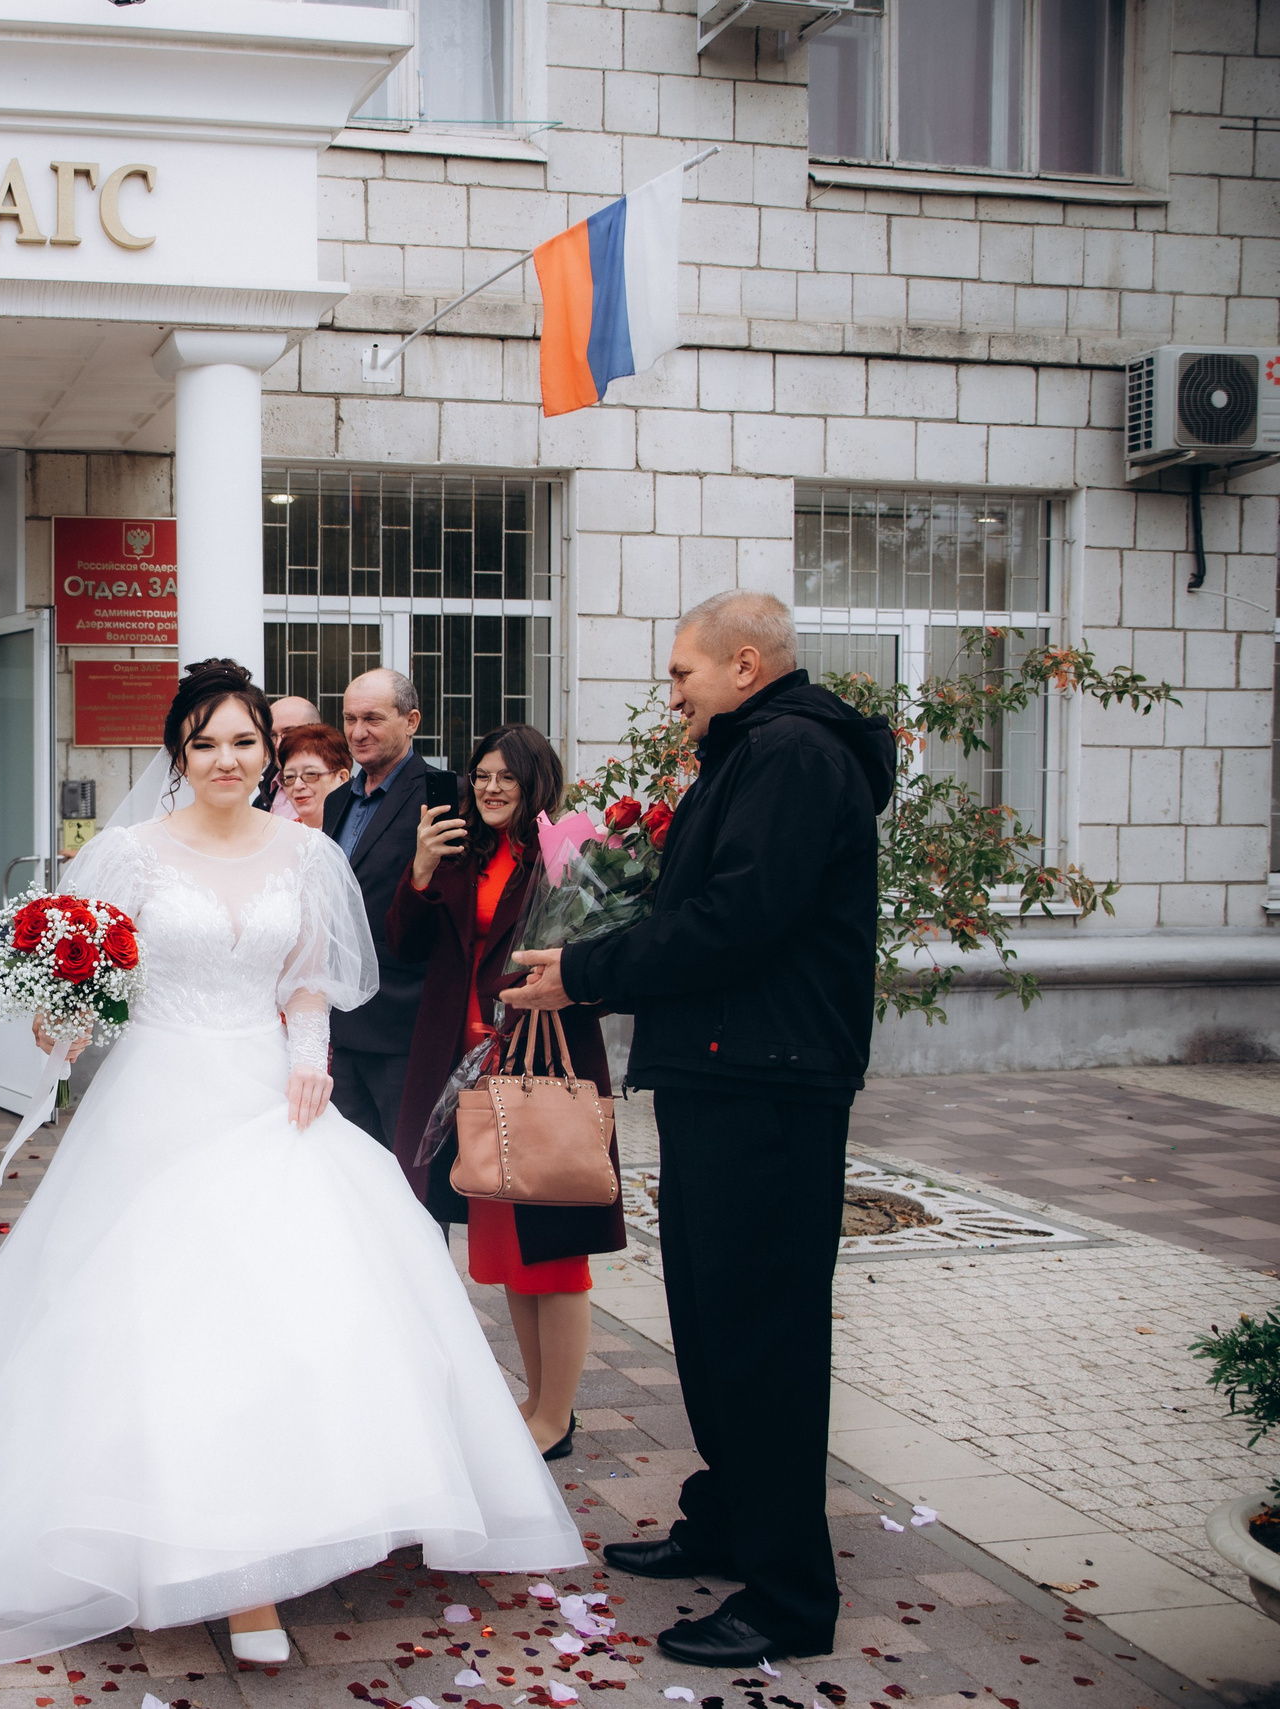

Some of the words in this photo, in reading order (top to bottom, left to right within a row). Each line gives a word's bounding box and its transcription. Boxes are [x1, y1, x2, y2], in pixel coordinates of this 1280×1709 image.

[77, 561, 138, 571] Российская
[64, 575, 142, 600] Отдел
[94, 608, 178, 619] администрации
[76, 619, 155, 630] Дзержинского
[106, 632, 167, 642] Волгограда
[140, 664, 162, 673] ЗАГС
